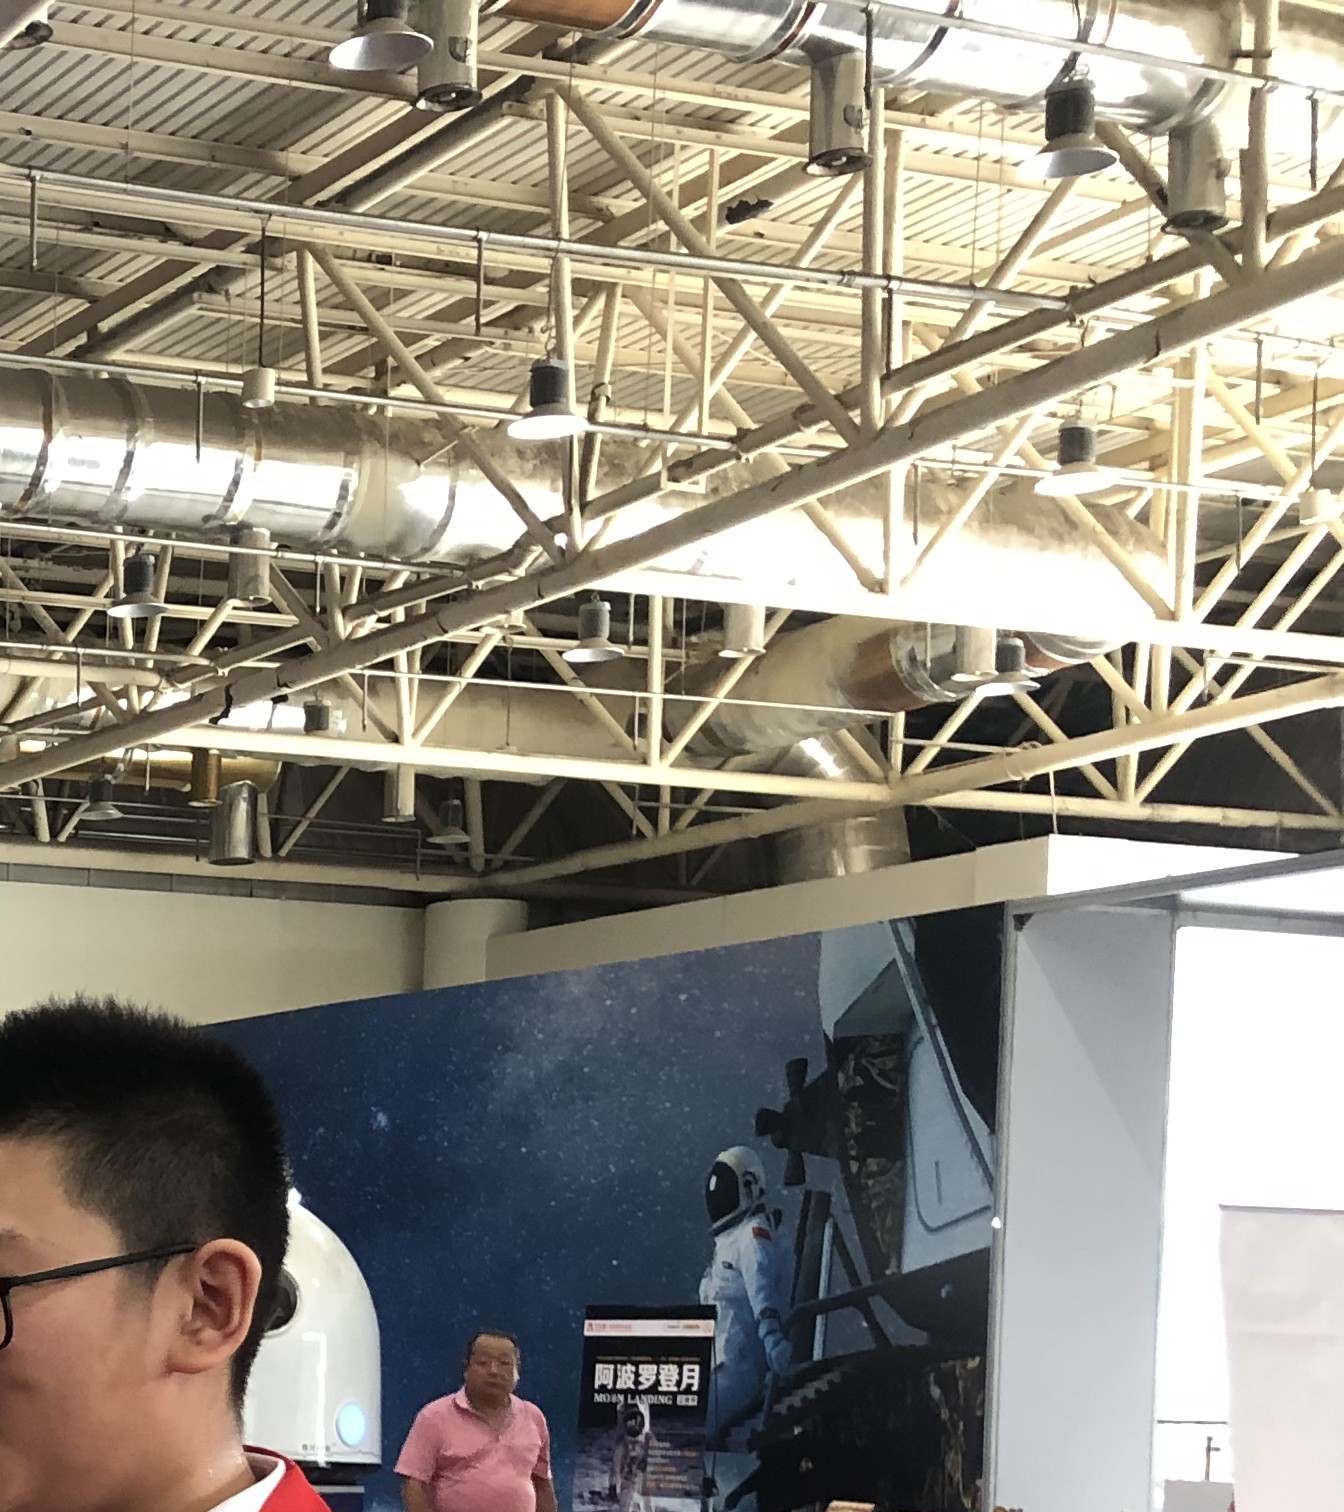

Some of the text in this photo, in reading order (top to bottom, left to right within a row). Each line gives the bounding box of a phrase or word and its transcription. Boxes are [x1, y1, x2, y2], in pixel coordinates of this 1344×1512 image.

[594, 1363, 700, 1392] 阿波罗登月
